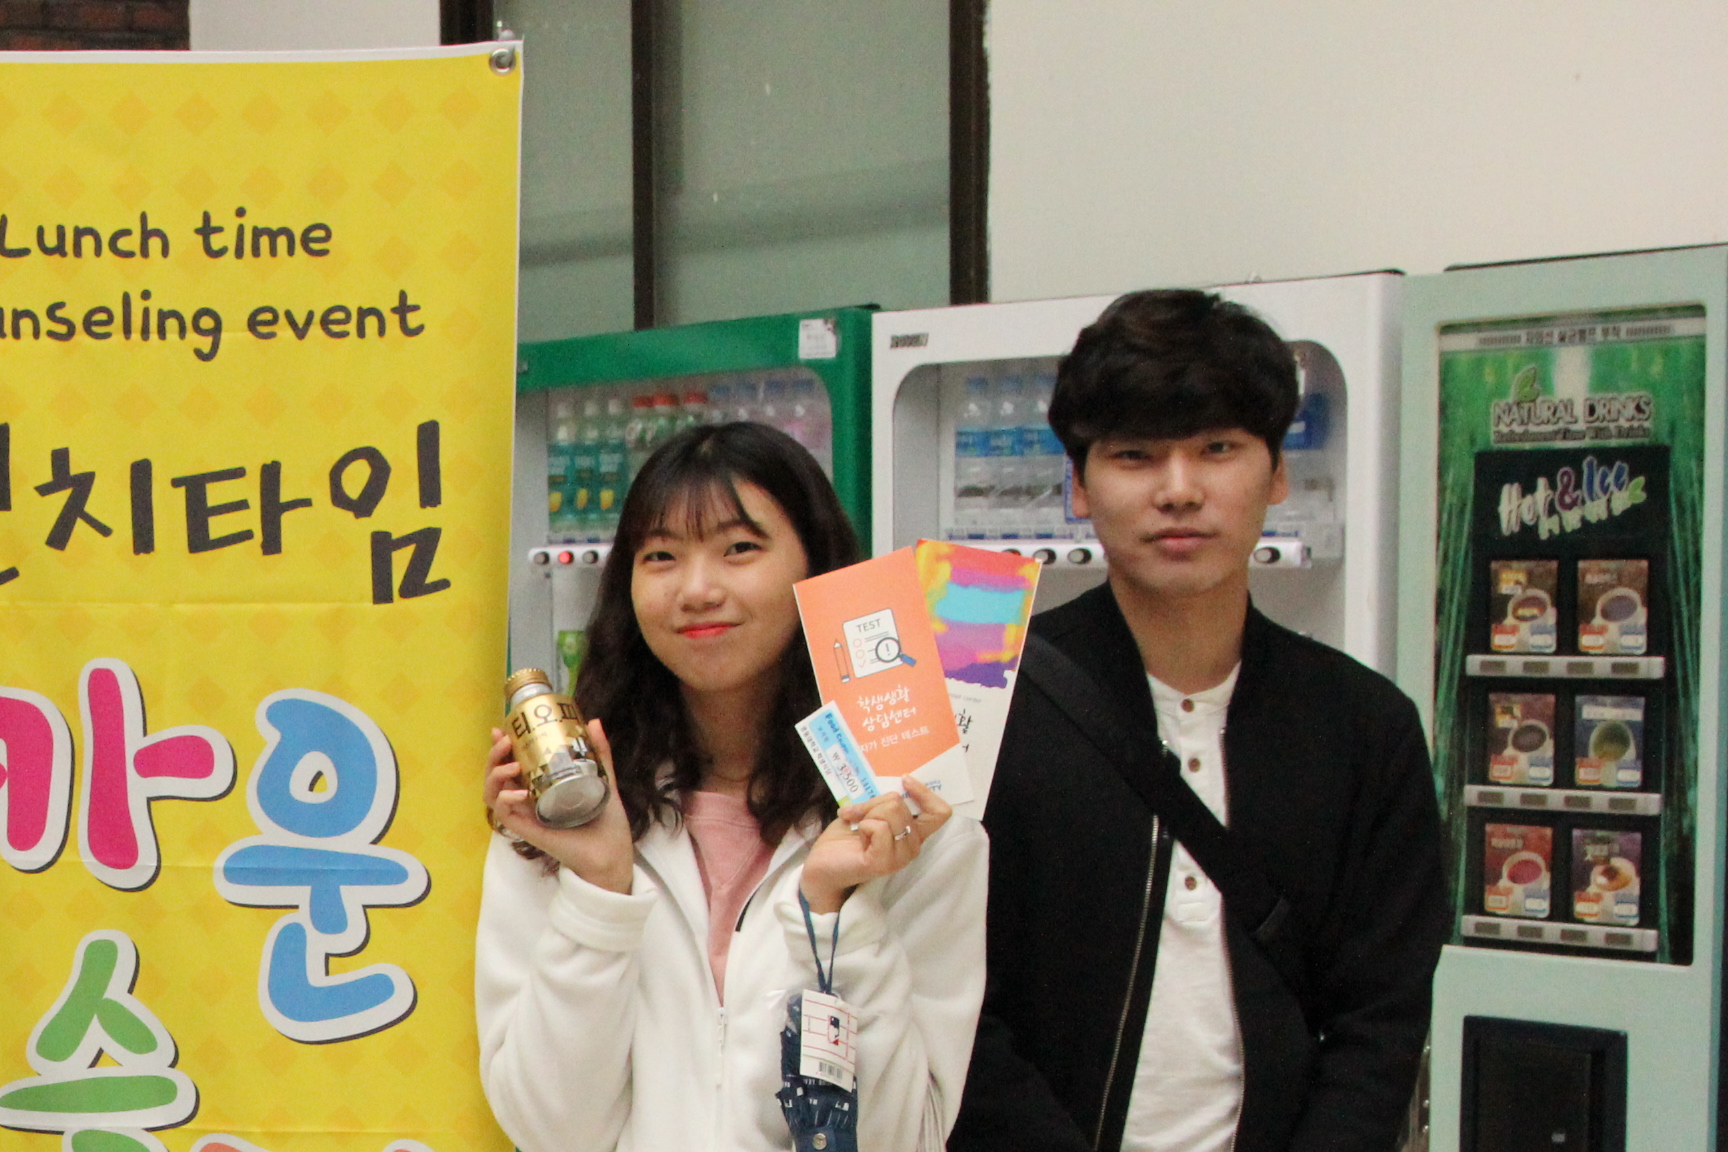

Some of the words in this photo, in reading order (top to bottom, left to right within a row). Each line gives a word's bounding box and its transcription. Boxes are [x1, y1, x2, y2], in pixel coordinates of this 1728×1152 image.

[194, 206, 334, 260] time
[246, 289, 427, 342] event
[1493, 397, 1578, 428] NATURAL
[1583, 393, 1653, 425] DRINKS
[856, 618, 882, 634] TEST
[856, 684, 910, 713] 학생생활
[862, 707, 917, 732] 상담센터
[859, 738, 878, 753] 자가
[880, 733, 899, 748] 진단
[900, 725, 930, 741] 테스트
[837, 763, 859, 793] 3,500
